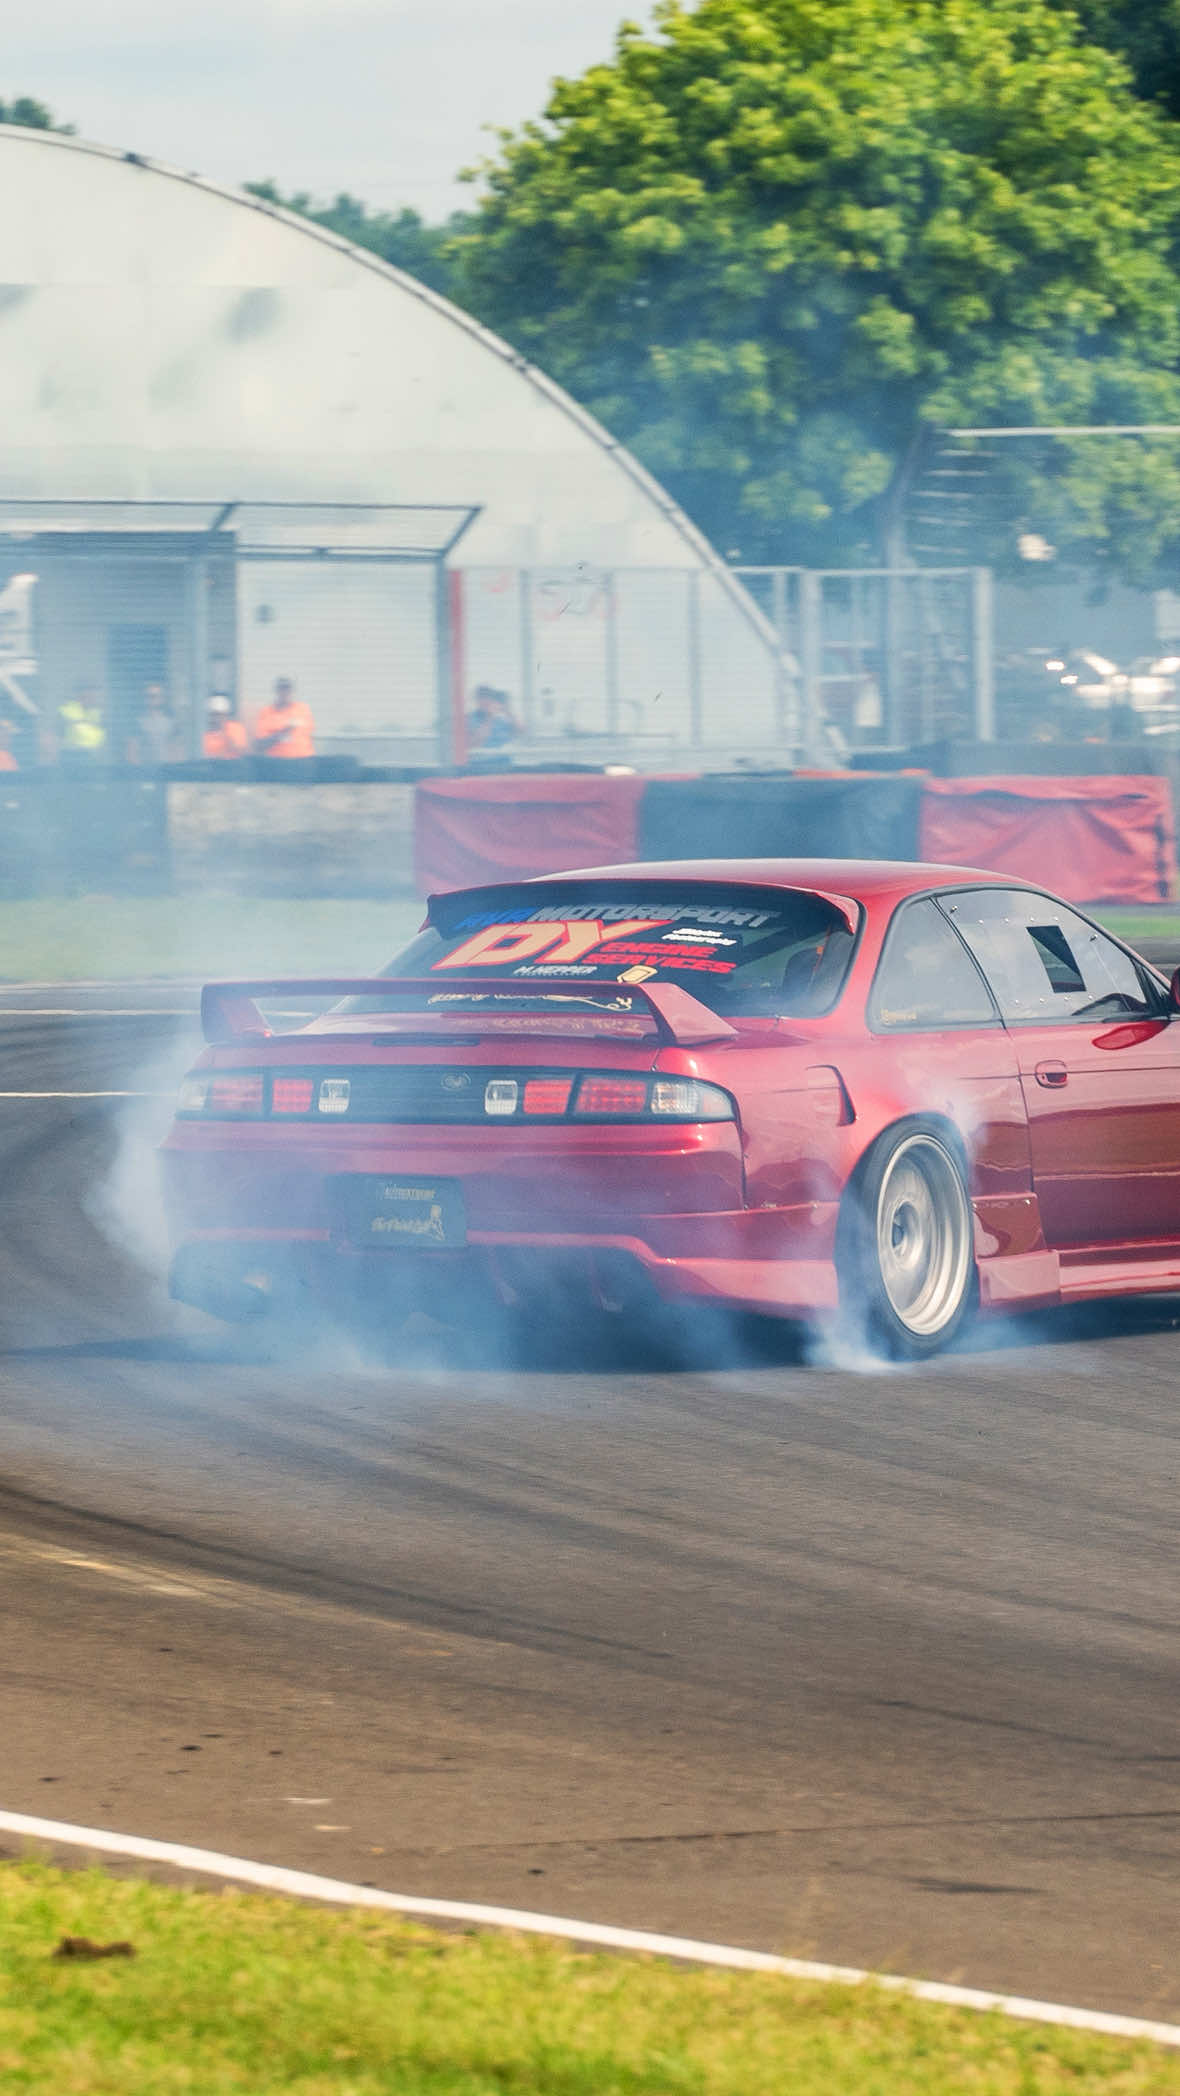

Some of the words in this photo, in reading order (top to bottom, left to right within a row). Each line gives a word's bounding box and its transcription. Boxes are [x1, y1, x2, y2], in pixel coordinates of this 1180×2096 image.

[432, 918, 675, 971] DY
[600, 941, 718, 958] ENGINE
[581, 953, 736, 974] SERVICES
